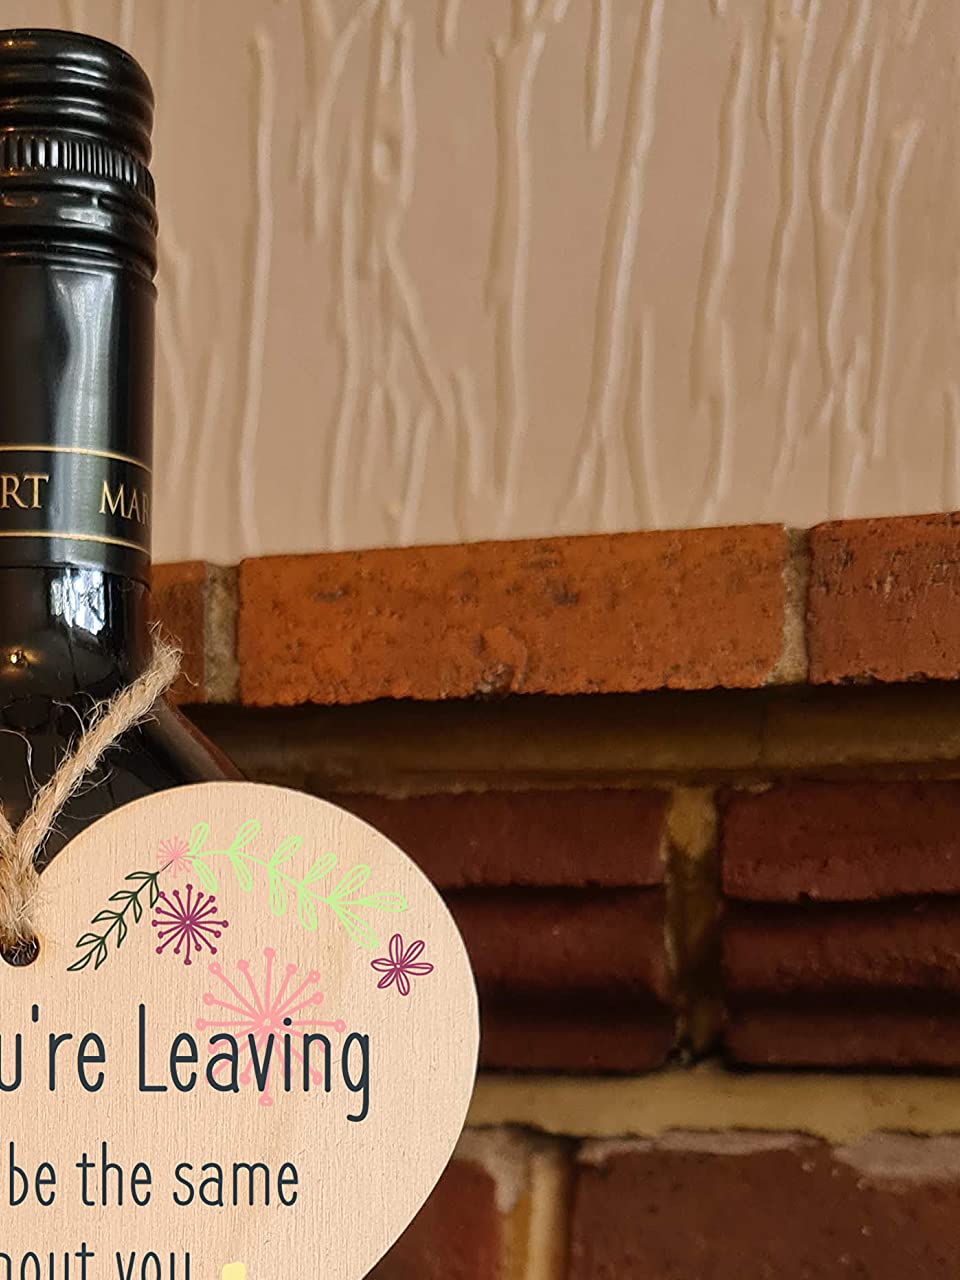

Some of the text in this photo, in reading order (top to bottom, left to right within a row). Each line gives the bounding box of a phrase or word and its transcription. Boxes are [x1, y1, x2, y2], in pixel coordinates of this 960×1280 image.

[138, 1003, 370, 1122] Leaving
[9, 1140, 57, 1207] be
[76, 1140, 153, 1207] the
[172, 1161, 299, 1207] same
